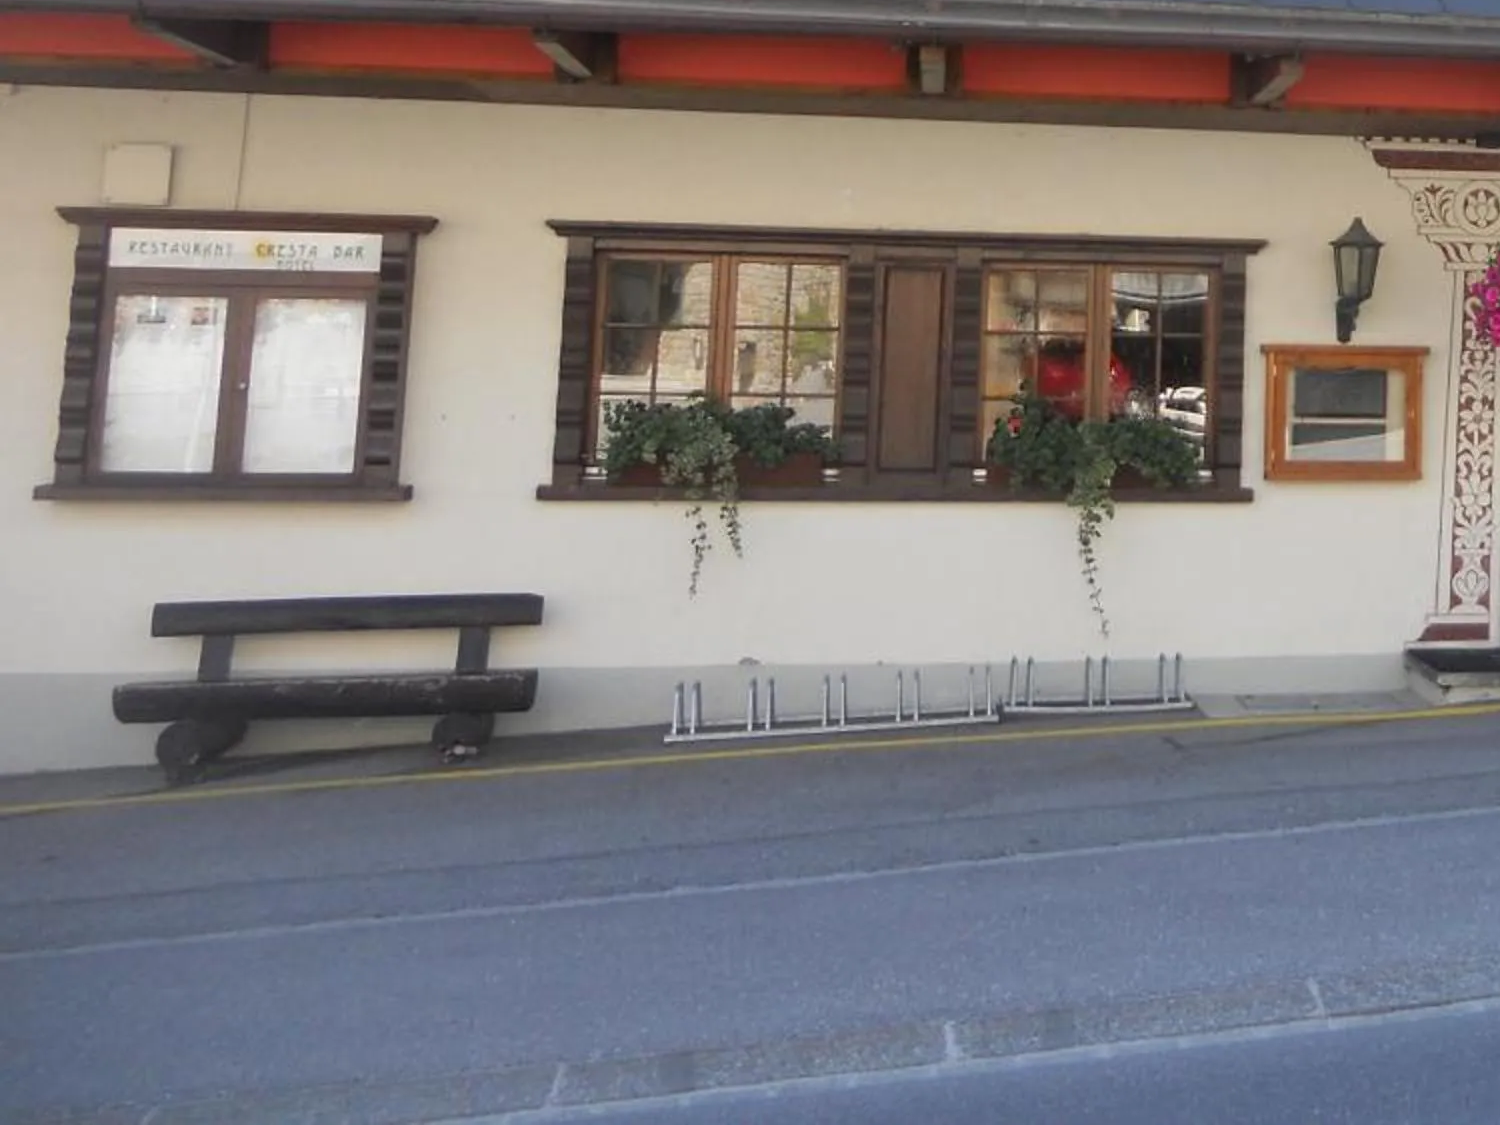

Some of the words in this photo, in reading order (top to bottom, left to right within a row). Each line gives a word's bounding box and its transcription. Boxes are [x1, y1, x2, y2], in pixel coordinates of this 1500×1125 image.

[127, 241, 233, 258] RESTAURANT
[255, 242, 318, 259] CRESTA
[333, 244, 365, 260] BAR
